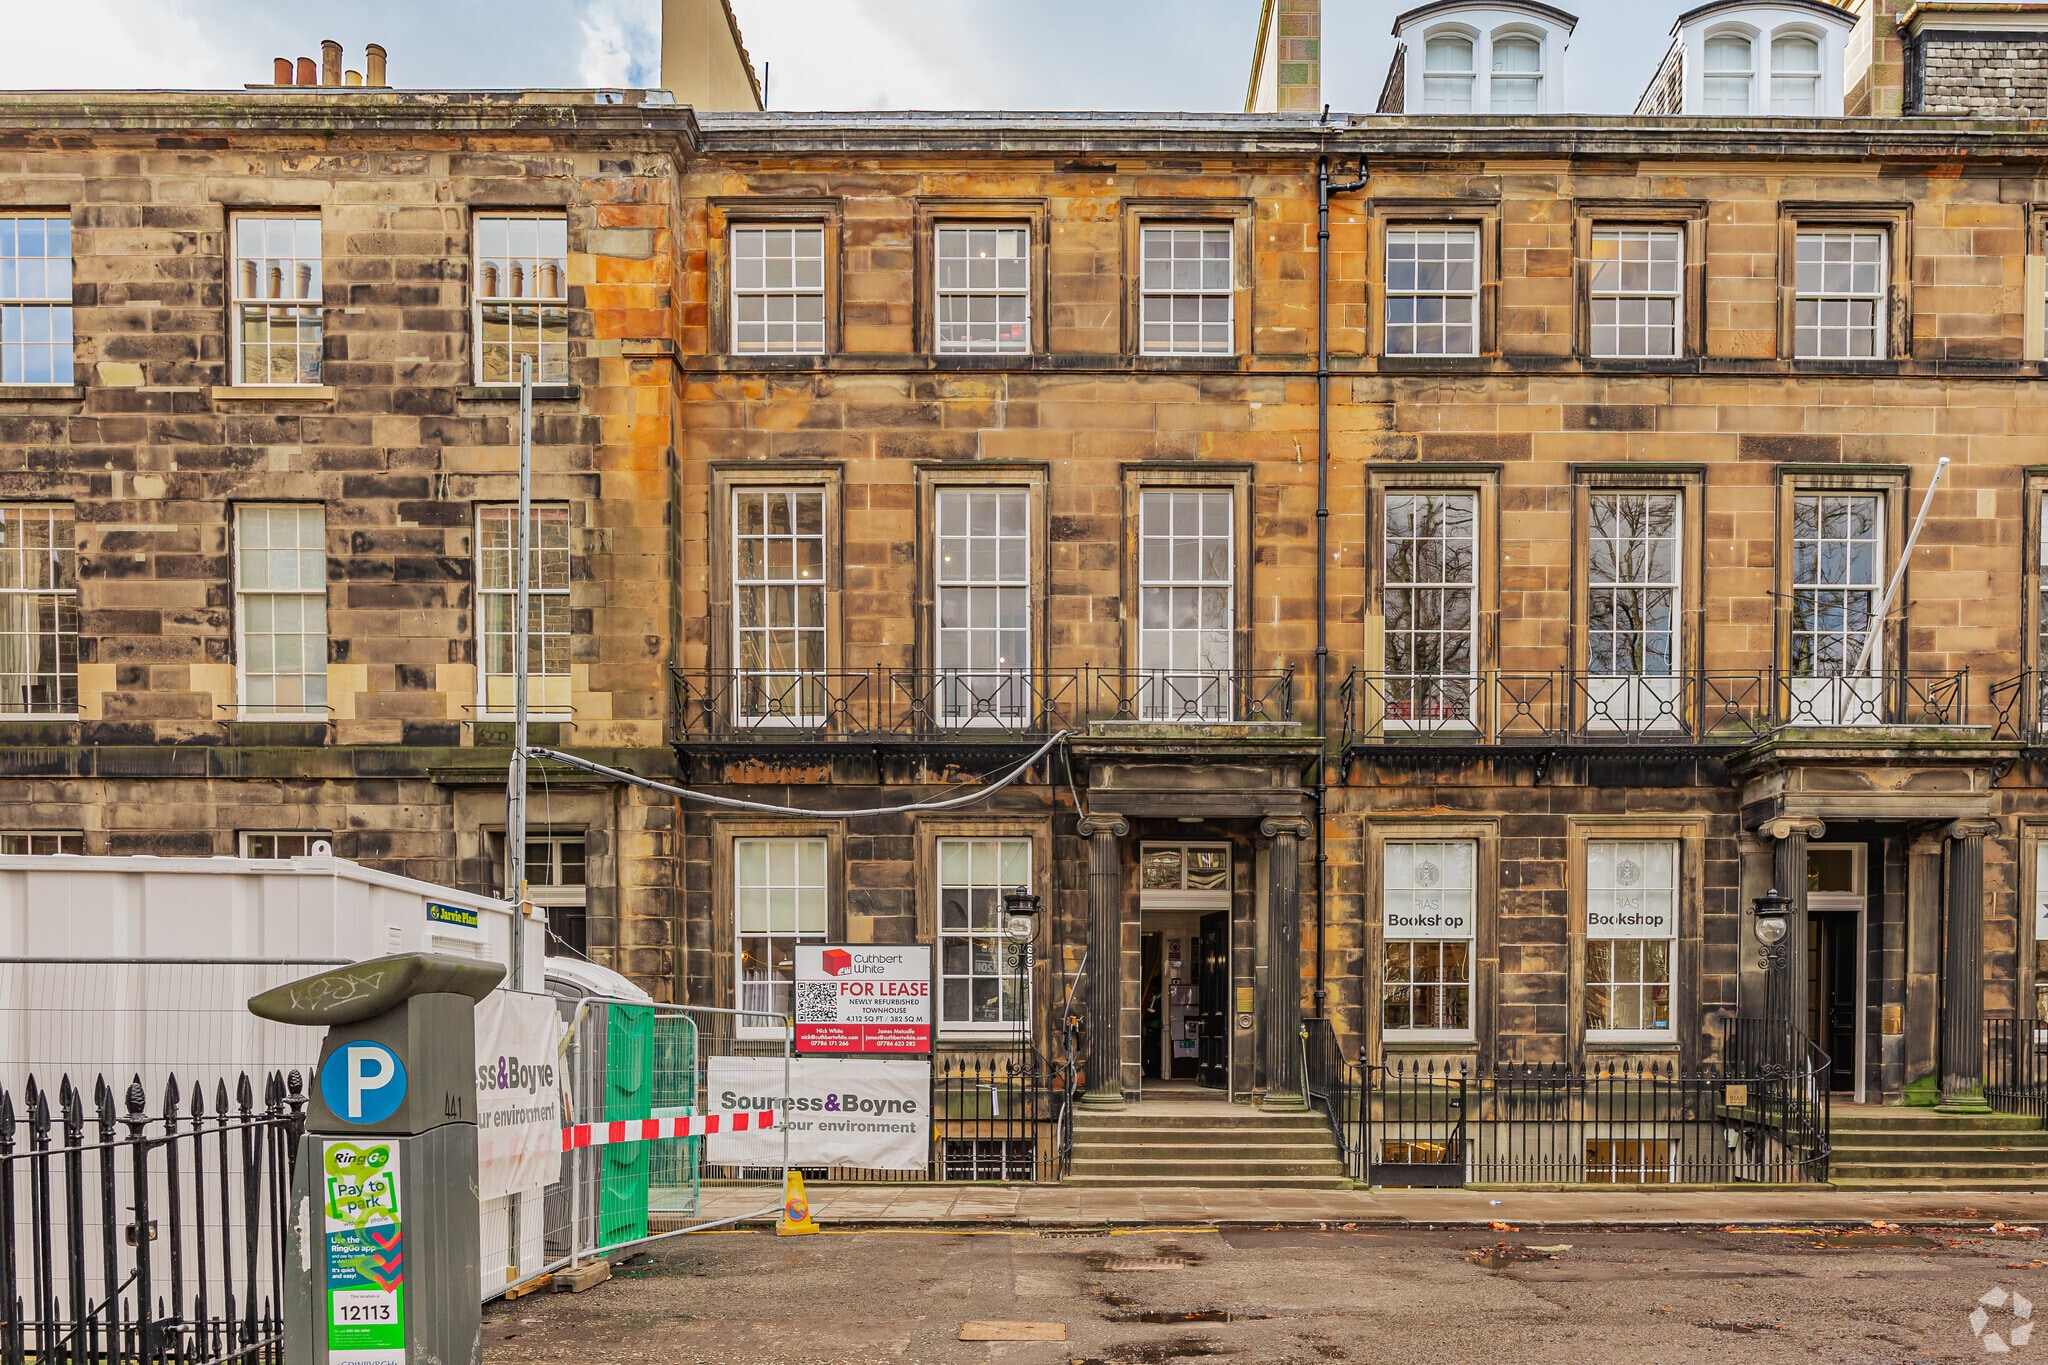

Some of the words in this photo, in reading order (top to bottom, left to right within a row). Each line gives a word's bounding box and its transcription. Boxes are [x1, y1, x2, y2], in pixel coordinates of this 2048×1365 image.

[1414, 899, 1439, 911] RIAS
[440, 907, 462, 923] Jarvie
[1388, 914, 1464, 929] Bookshop
[1588, 912, 1664, 927] Bookshop
[854, 954, 903, 964] Cuthbert
[854, 964, 885, 974] White
[840, 982, 875, 996] FOR
[880, 982, 928, 996] LEASE
[348, 1046, 395, 1118] P
[494, 1101, 555, 1128] environment
[818, 1119, 917, 1133] environment
[334, 1152, 386, 1165] RingGo
[338, 1184, 364, 1197] Pay
[368, 1181, 385, 1192] to
[347, 1195, 381, 1214] park
[331, 1245, 360, 1254] RingGo
[360, 1245, 376, 1253] app
[340, 1305, 391, 1321] 12113
